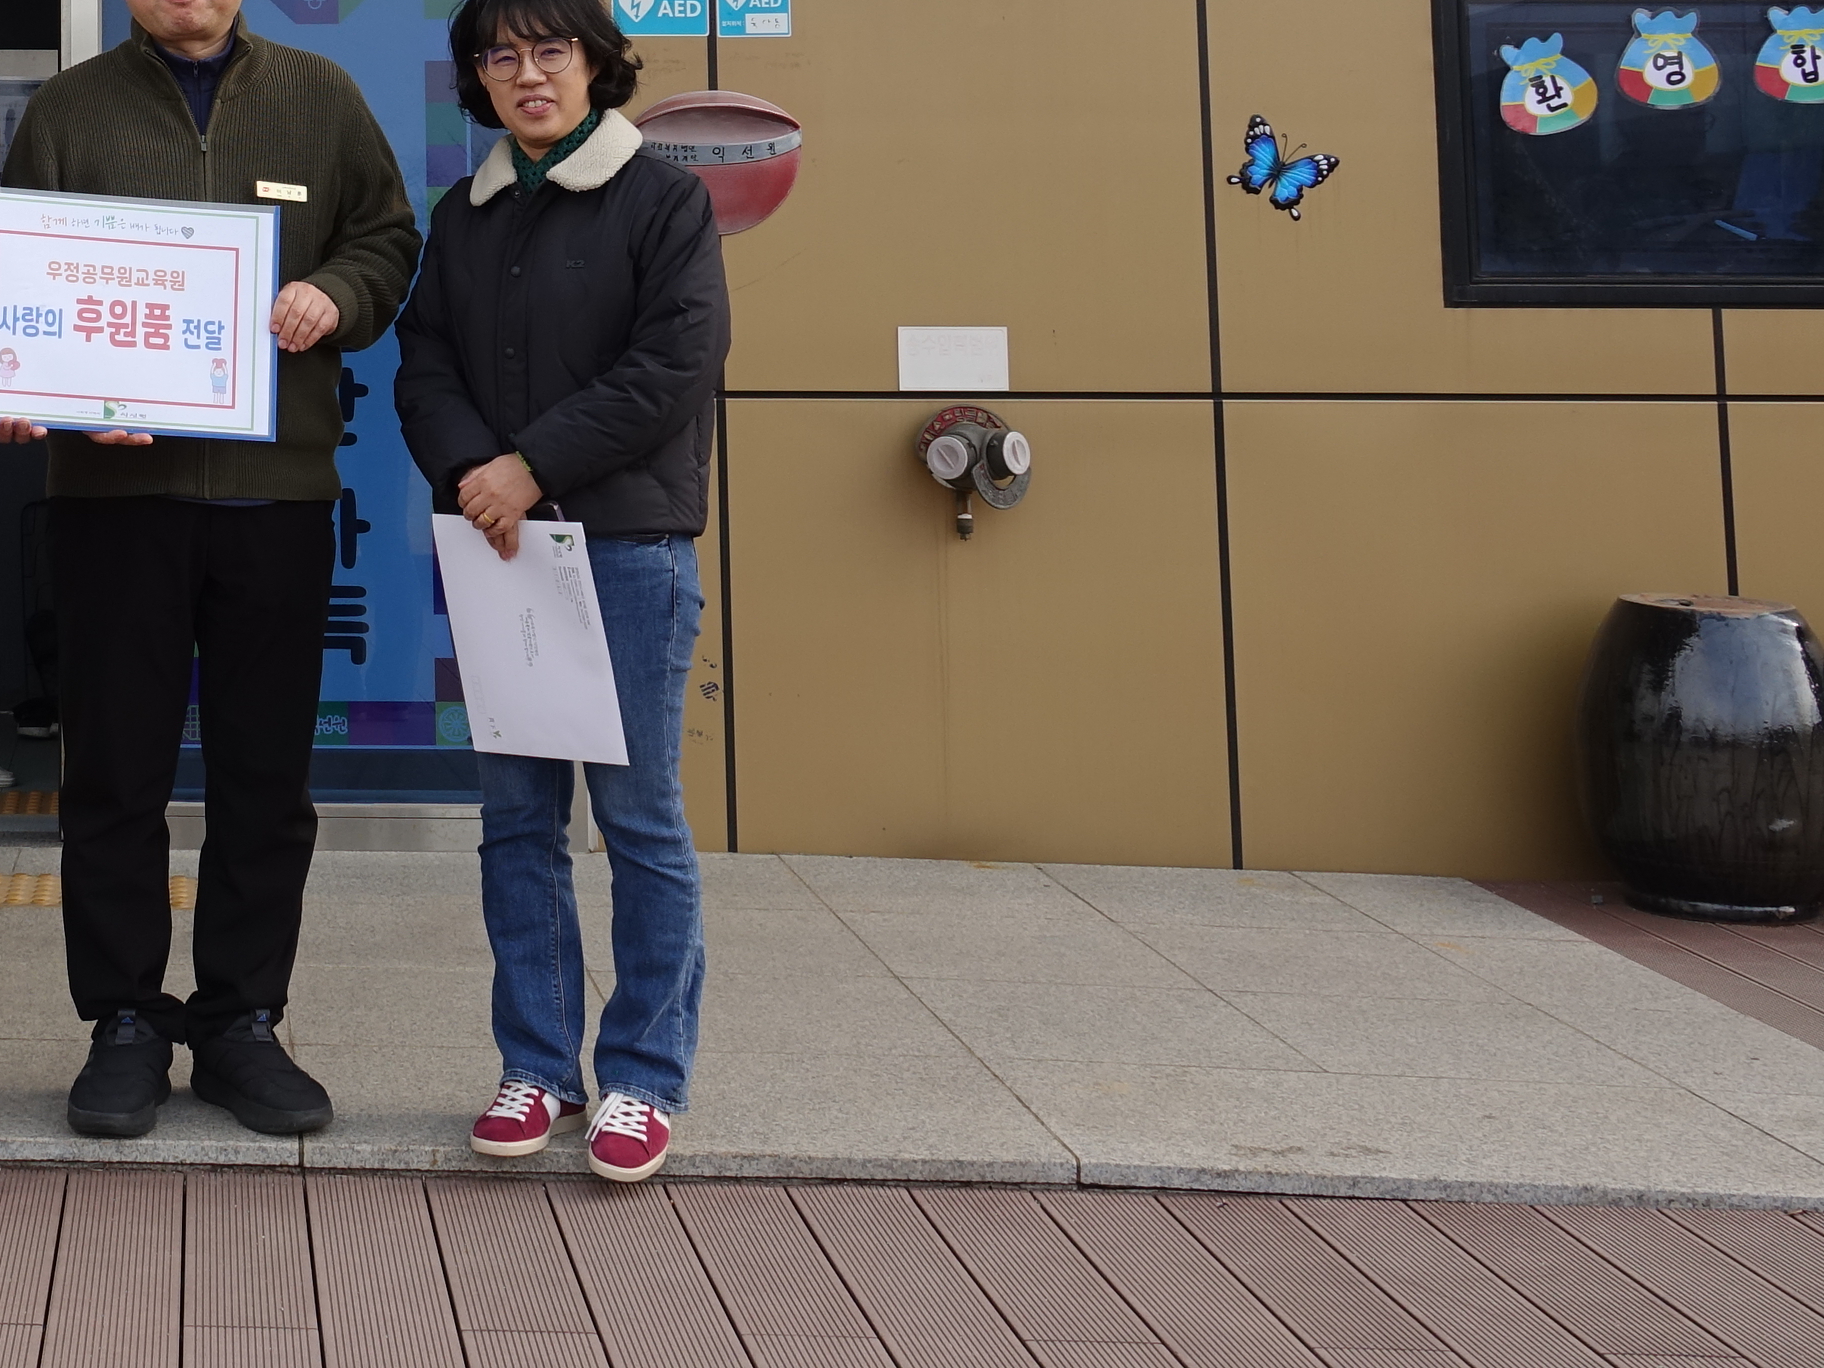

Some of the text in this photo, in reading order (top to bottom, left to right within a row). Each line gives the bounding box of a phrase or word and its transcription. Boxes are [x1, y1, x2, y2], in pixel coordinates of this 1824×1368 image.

[657, 0, 702, 18] AED
[1528, 44, 1822, 112] 환 영 합
[712, 142, 777, 163] 익선원
[40, 214, 68, 229] 함께
[71, 218, 91, 229] 하면
[94, 215, 127, 230] 기쁨은
[154, 224, 179, 236] 됩니다
[566, 259, 585, 269] K2
[45, 260, 187, 292] 우정공무원교육원
[72, 294, 173, 352] 후원품
[181, 318, 226, 352] 전달
